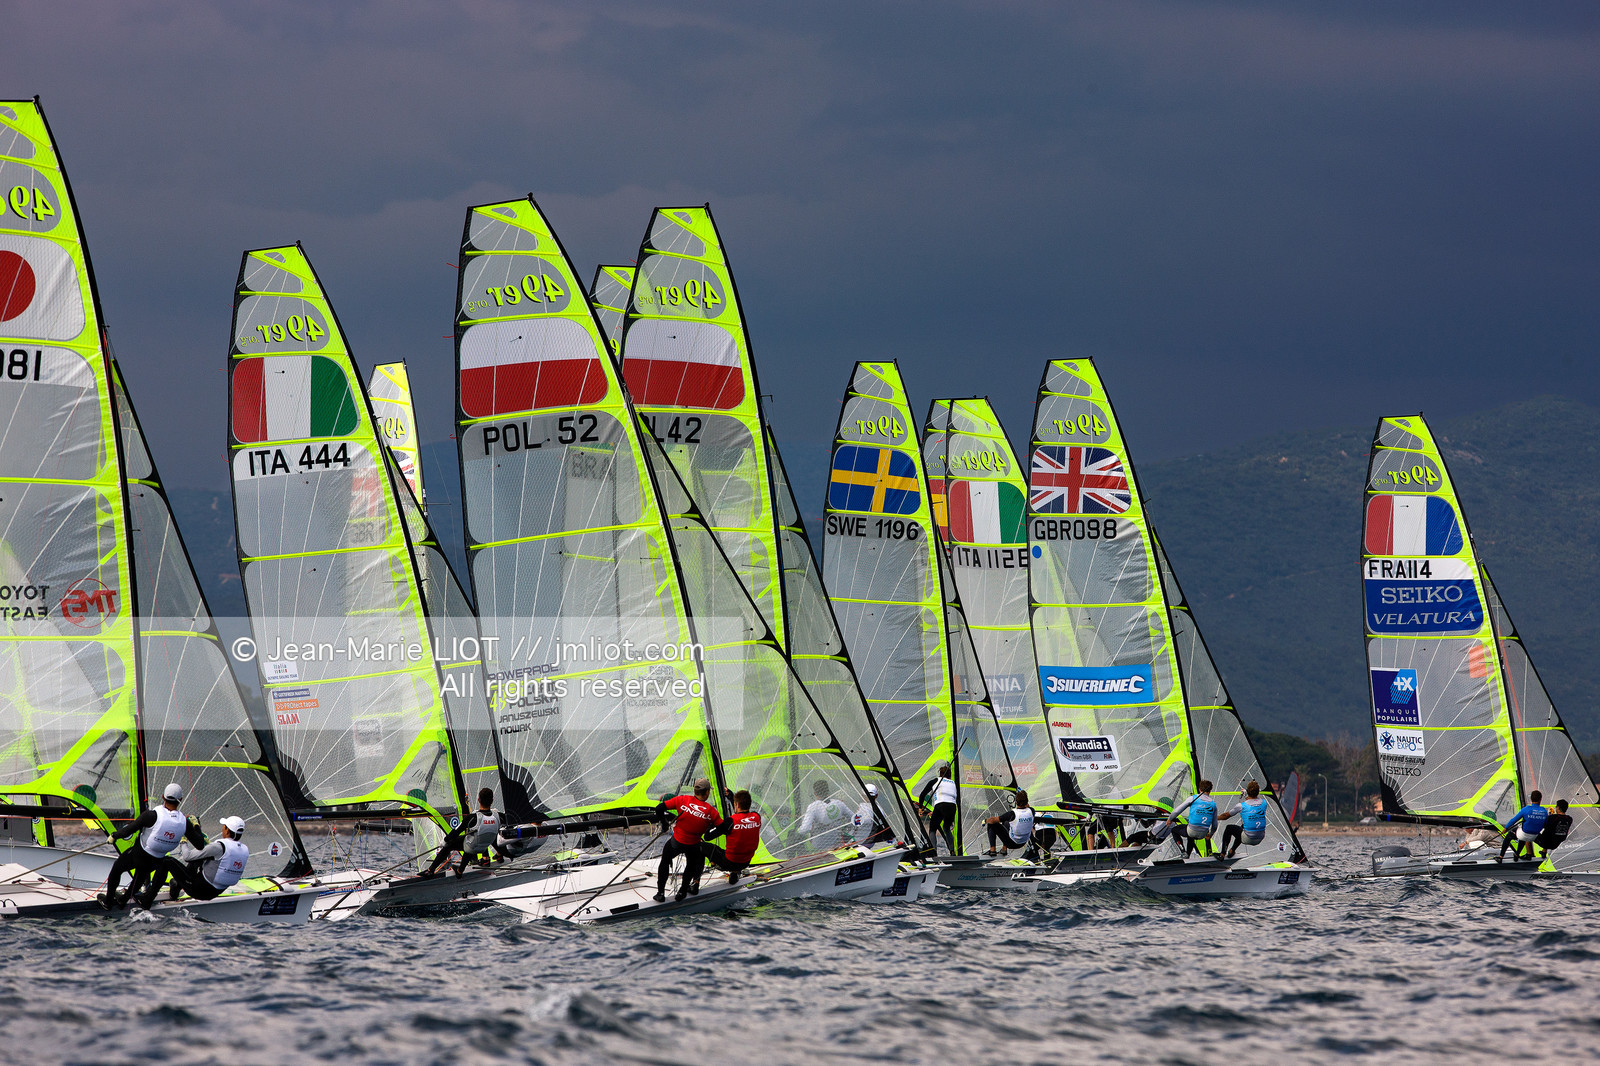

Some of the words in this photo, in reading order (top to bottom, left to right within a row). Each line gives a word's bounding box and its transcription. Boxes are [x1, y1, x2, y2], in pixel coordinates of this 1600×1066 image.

[483, 421, 542, 455] POL
[558, 414, 599, 444] 52
[248, 449, 291, 476] ITA
[299, 443, 351, 470] 444
[827, 516, 867, 536] SWE
[875, 519, 920, 541] 1196
[957, 547, 982, 568] ITA
[1381, 585, 1463, 604] SEIKO
[1373, 611, 1476, 625] VELATURA
[1376, 707, 1416, 715] BANQUE
[1377, 715, 1418, 723] POPULAIRE
[1396, 735, 1423, 744] NAUTIC
[1386, 765, 1422, 777] SEIKO
